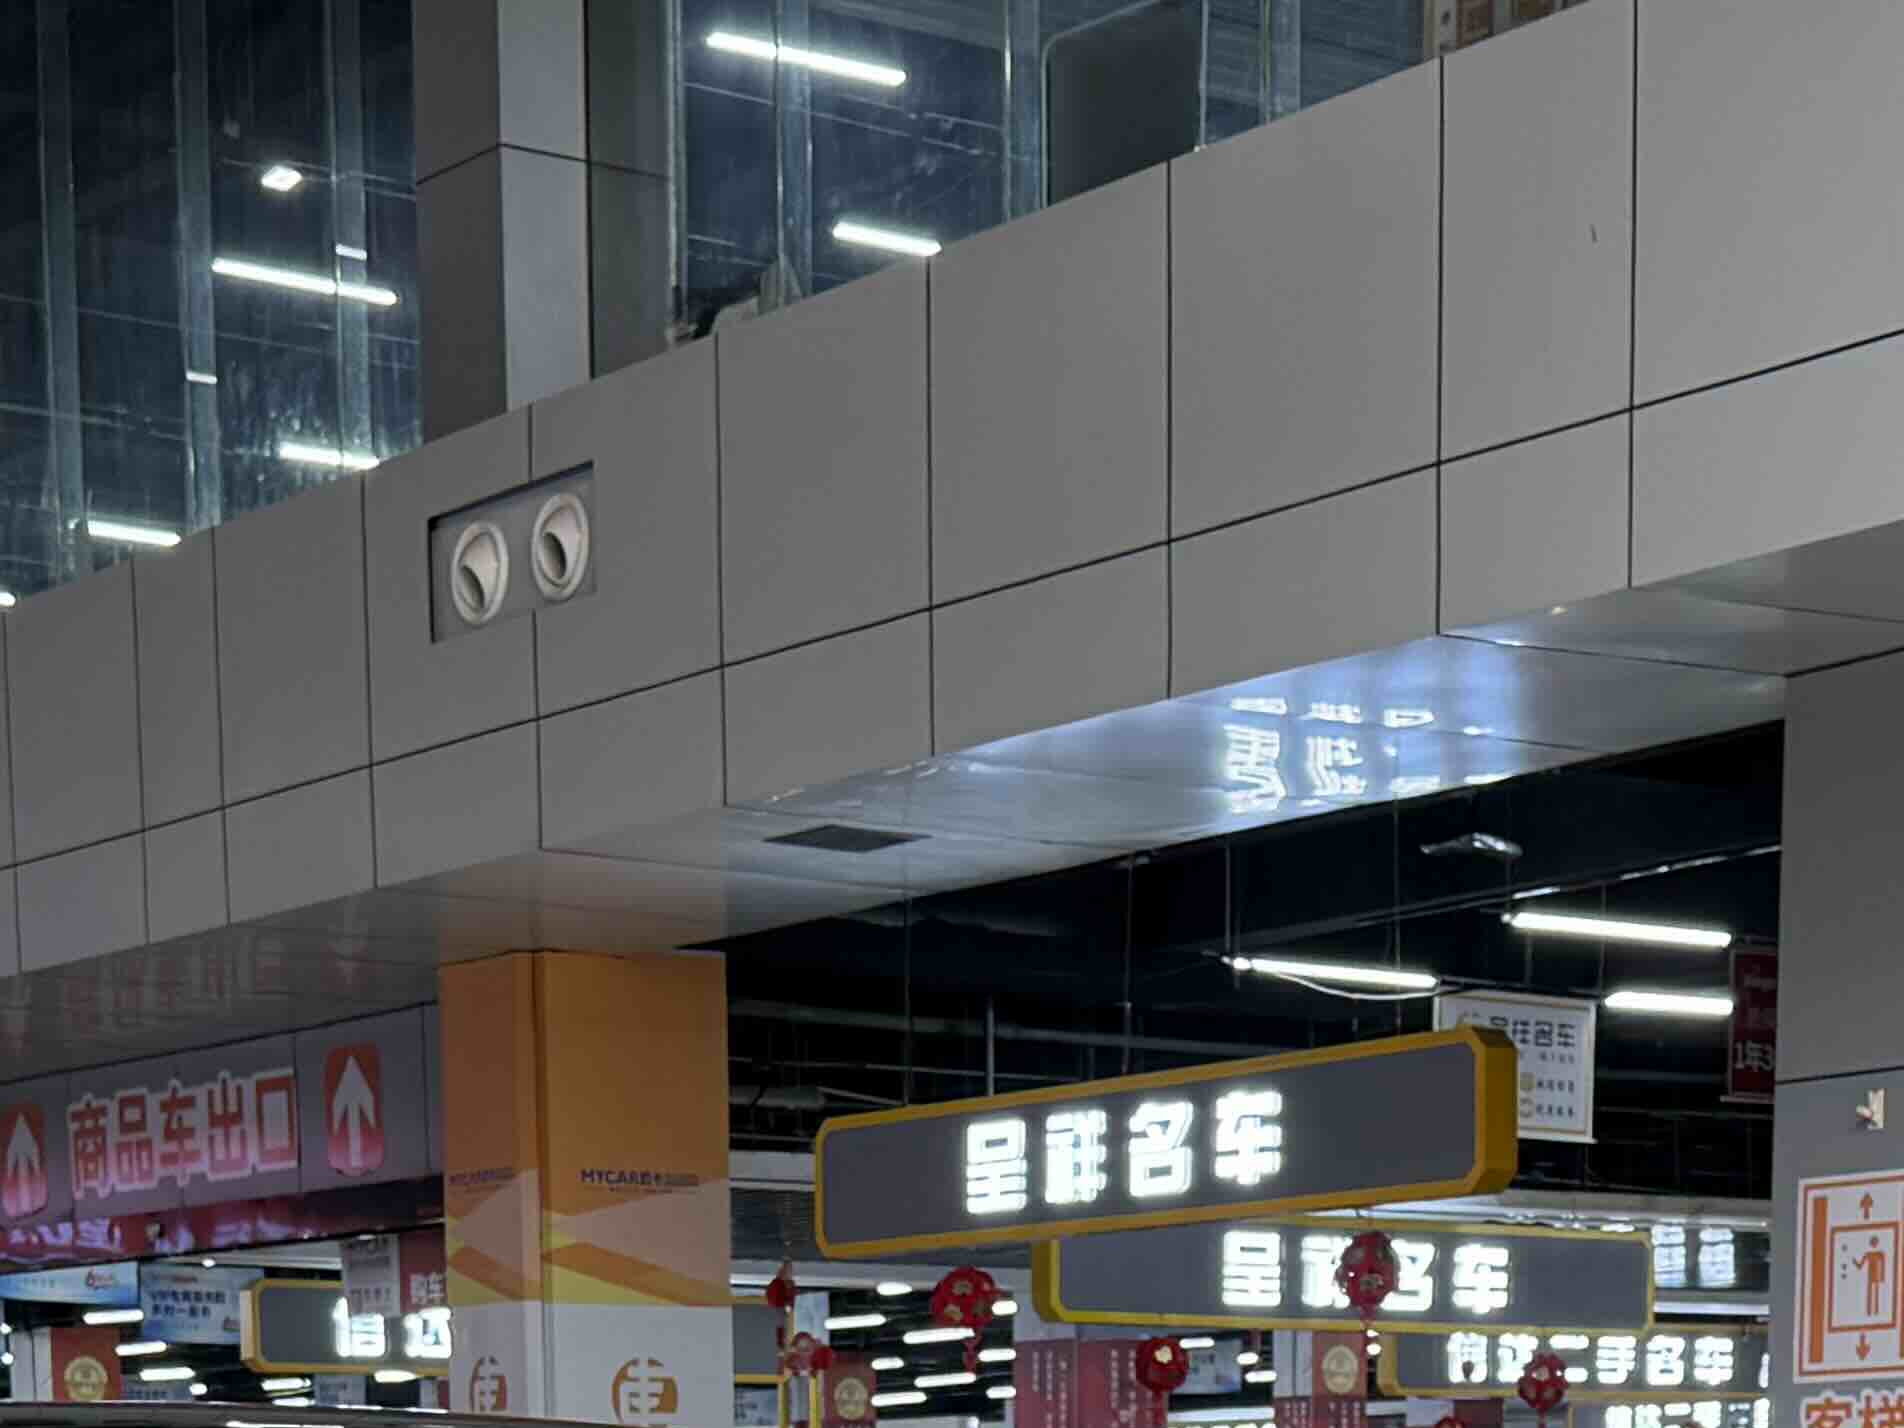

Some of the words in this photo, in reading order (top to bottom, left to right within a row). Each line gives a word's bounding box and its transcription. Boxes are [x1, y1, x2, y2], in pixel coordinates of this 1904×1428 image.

[68, 1070, 297, 1198] 商品车出口
[964, 1089, 1285, 1215] 呈祥名车
